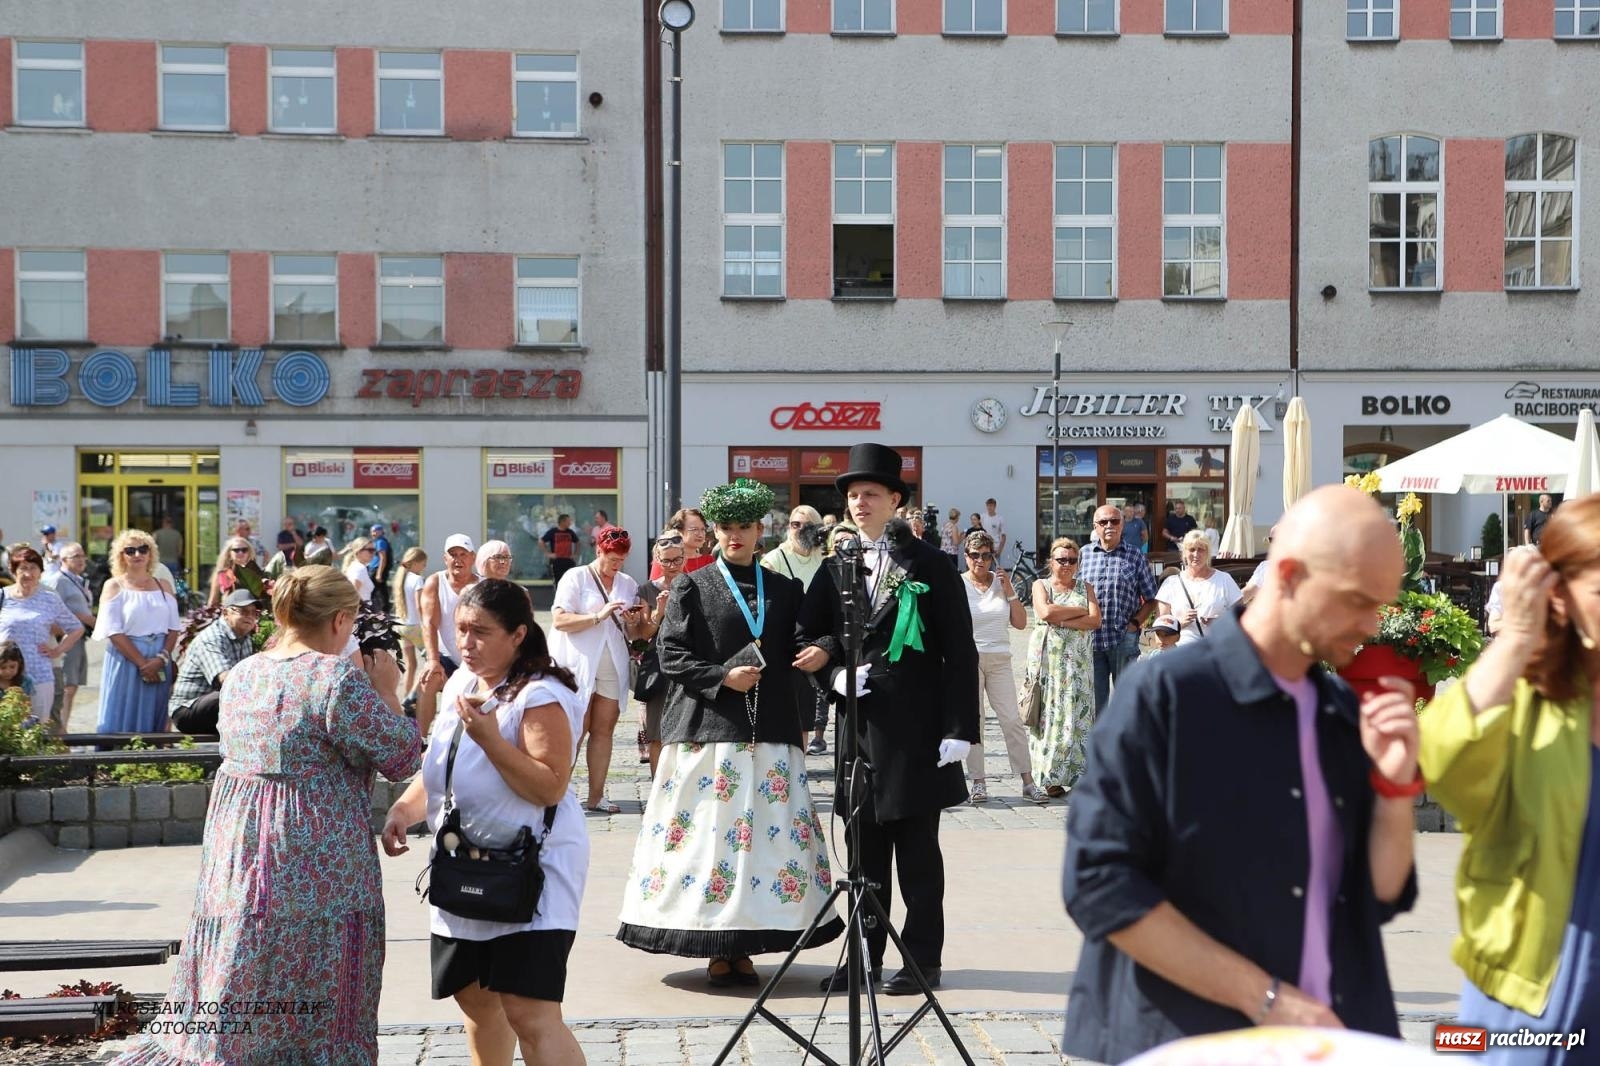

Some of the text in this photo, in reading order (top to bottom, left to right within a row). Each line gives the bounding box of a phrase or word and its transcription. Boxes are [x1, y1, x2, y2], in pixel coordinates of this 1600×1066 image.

[10, 347, 582, 408] BOLKO zaprasza
[1541, 388, 1600, 399] RESTAURA
[1019, 386, 1187, 417] JUBILER
[1361, 395, 1451, 416] BOLKO
[1047, 425, 1166, 438] ZEGARMISTRZ
[308, 462, 346, 474] Bliski
[508, 462, 545, 474] Bliski
